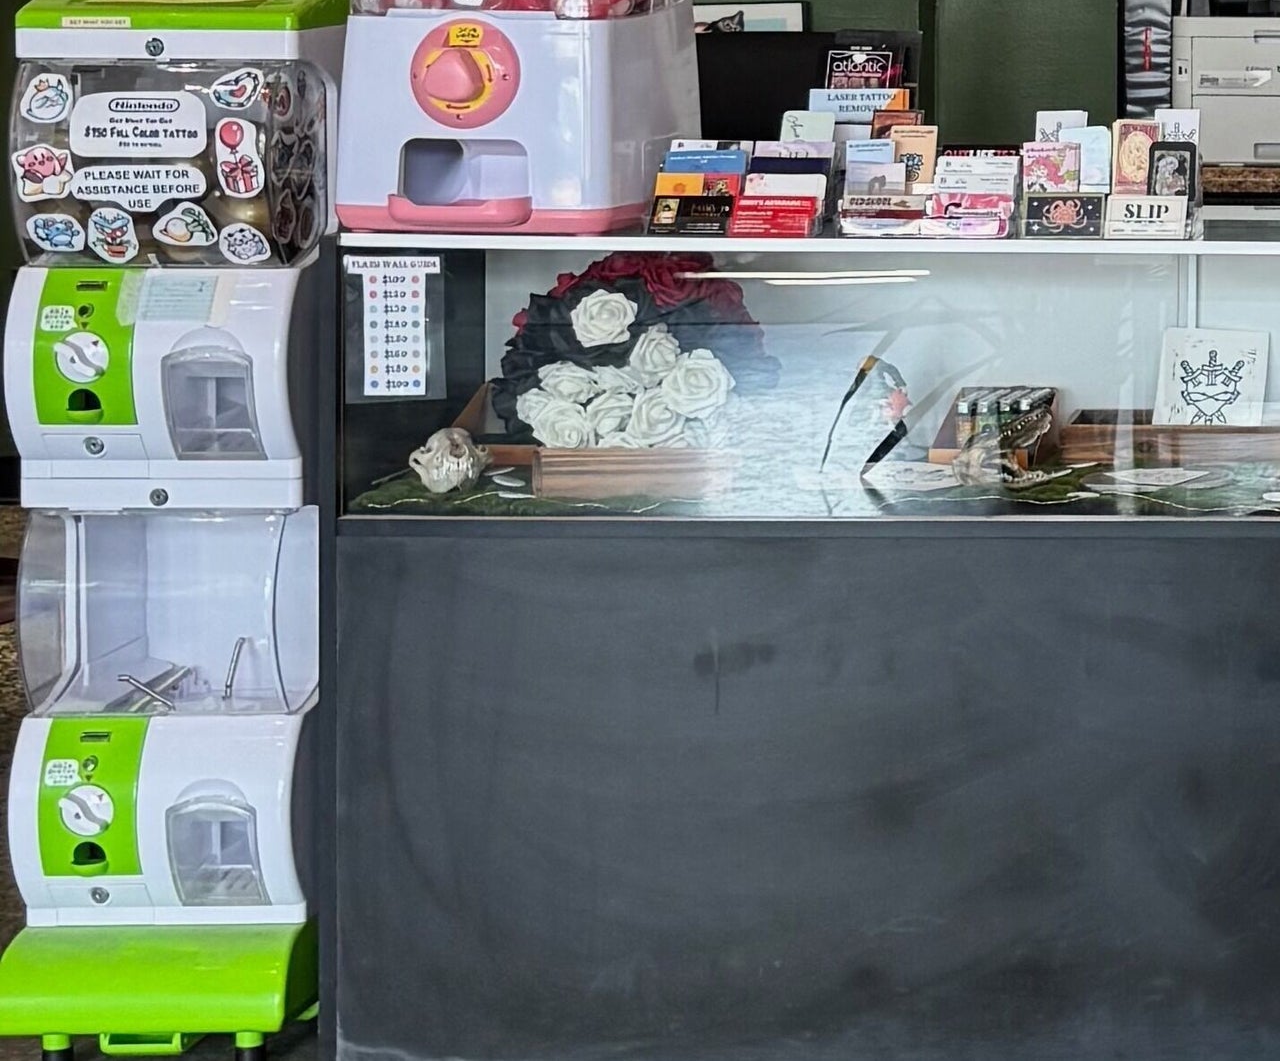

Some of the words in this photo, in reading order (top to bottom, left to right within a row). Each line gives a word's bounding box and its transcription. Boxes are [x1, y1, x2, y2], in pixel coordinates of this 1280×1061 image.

[832, 58, 884, 72] atlantic
[827, 93, 858, 101] LASER
[859, 93, 896, 101] TATTOO
[115, 101, 174, 110] Nintendo
[84, 170, 130, 180] PLEASE
[132, 170, 162, 179] WAIT
[165, 169, 190, 179] FOR
[77, 185, 149, 195] ASSISTANCE
[153, 184, 200, 194] BEFORE
[128, 199, 152, 208] USE
[1124, 204, 1169, 219] SLIP
[383, 260, 408, 268] WALL
